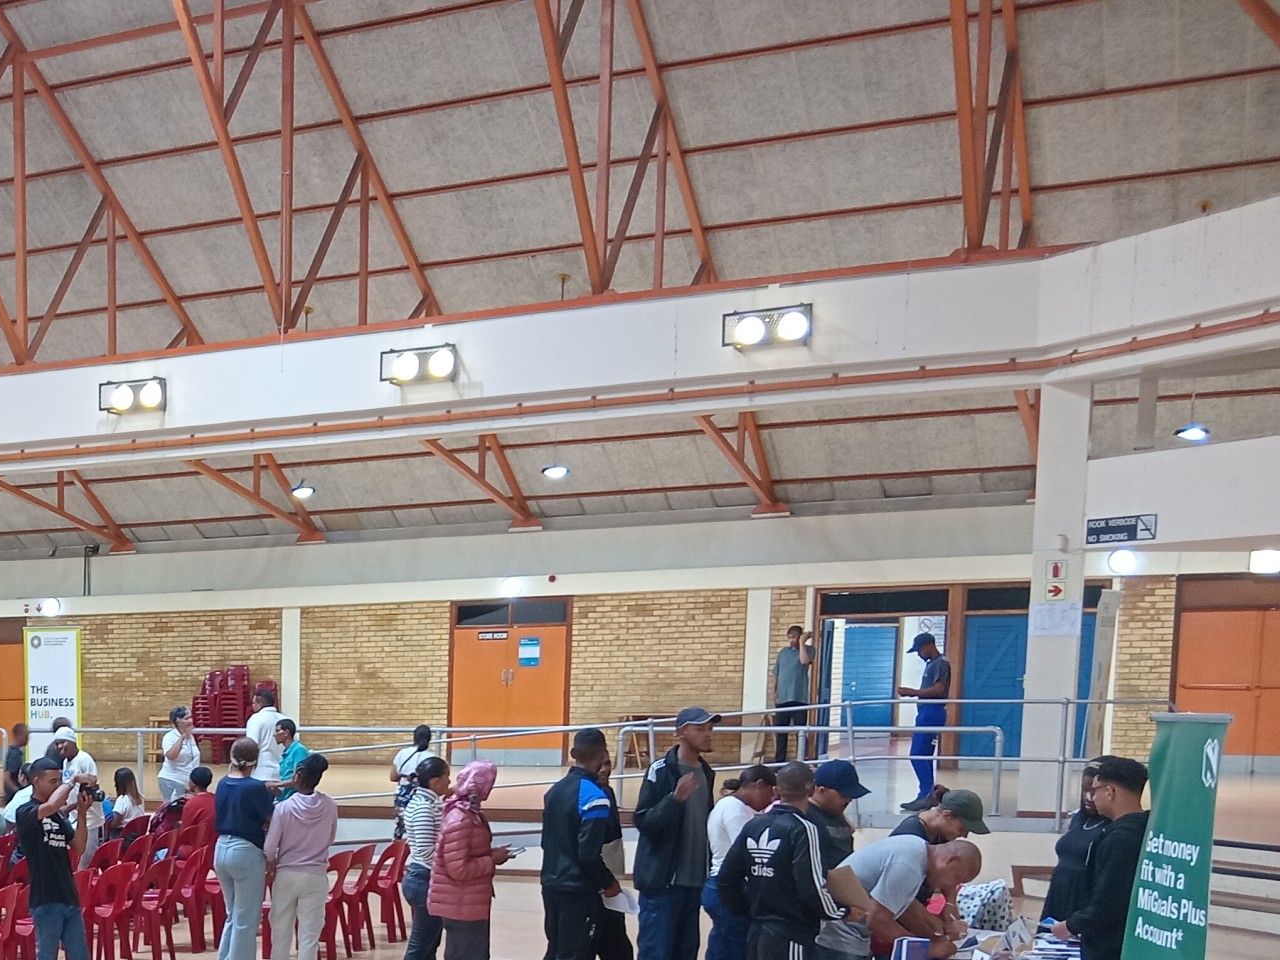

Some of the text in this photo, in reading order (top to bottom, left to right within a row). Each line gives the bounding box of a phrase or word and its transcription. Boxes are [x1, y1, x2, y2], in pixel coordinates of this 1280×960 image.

[1099, 533, 1128, 541] SMOKING
[30, 685, 49, 695] THE
[30, 698, 75, 707] BUSINESS
[31, 710, 53, 719] HUB.
[1163, 841, 1200, 867] money
[1140, 859, 1185, 890] fit with a
[1137, 887, 1207, 927] MiGoals Plus
